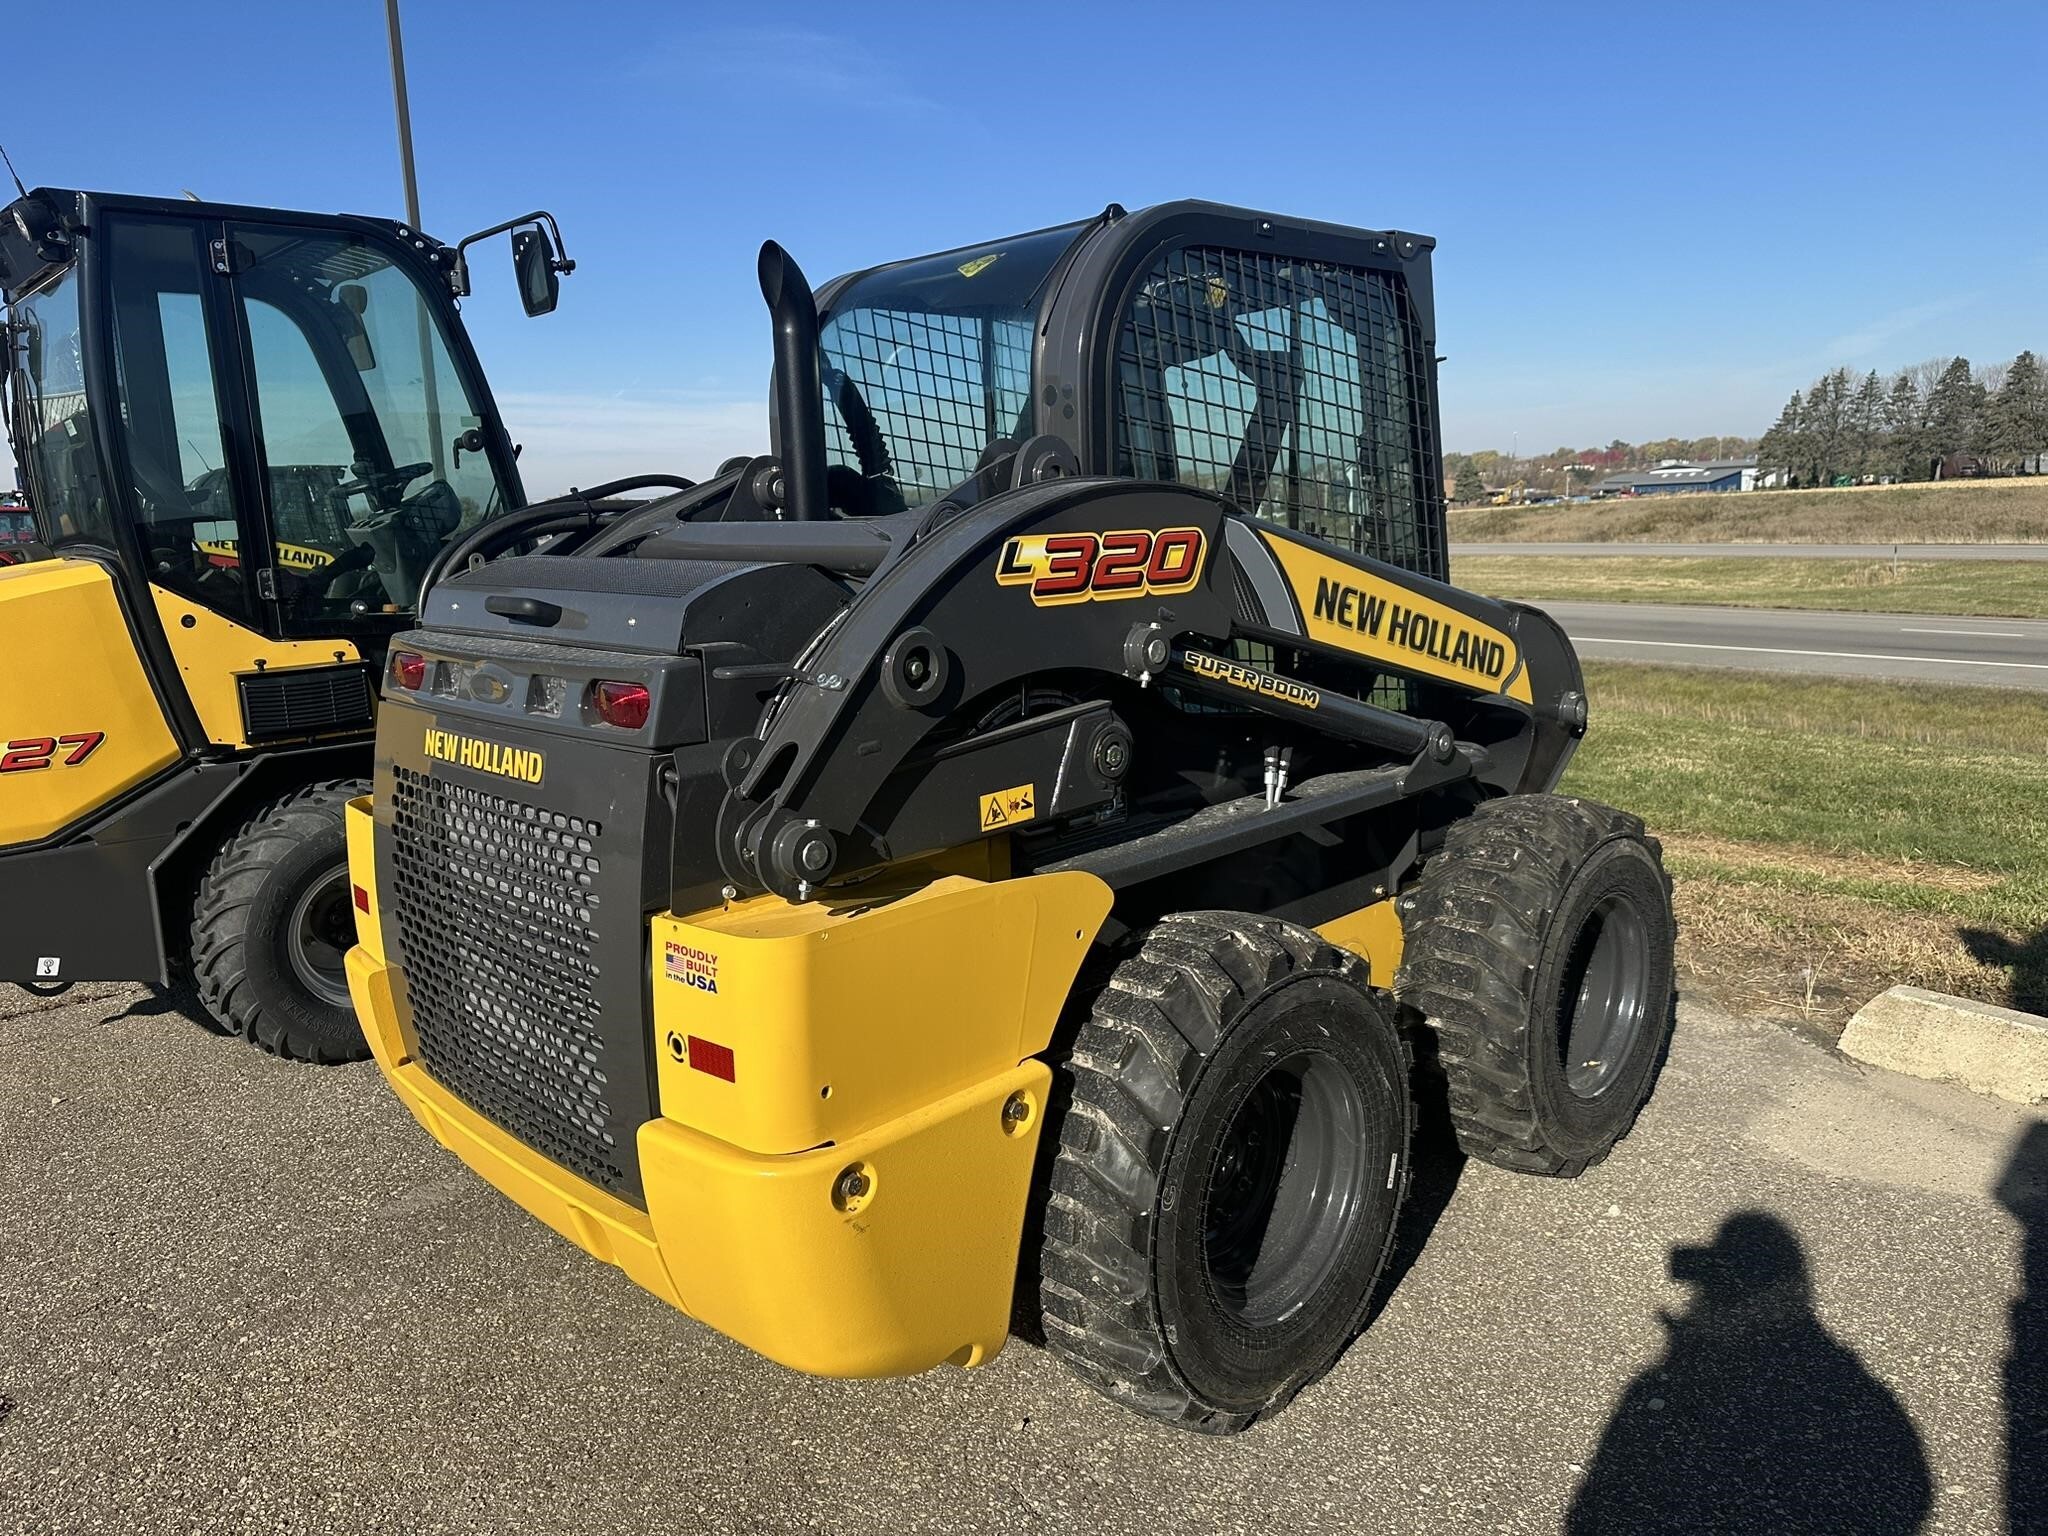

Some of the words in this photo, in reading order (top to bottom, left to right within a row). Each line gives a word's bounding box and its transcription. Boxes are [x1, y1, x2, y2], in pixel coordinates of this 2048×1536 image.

[996, 528, 1206, 604] L320
[1313, 576, 1386, 639] NEW
[1387, 604, 1505, 680] HOLLAND
[1184, 650, 1259, 691] SUPER
[1259, 673, 1320, 710] BOOM
[424, 728, 459, 763] NEW
[460, 736, 543, 784] HOLLAND
[665, 941, 718, 965] PROUDLY
[686, 959, 718, 978] BUILT
[665, 970, 673, 980] in
[673, 973, 686, 984] the
[686, 971, 718, 994] USA
